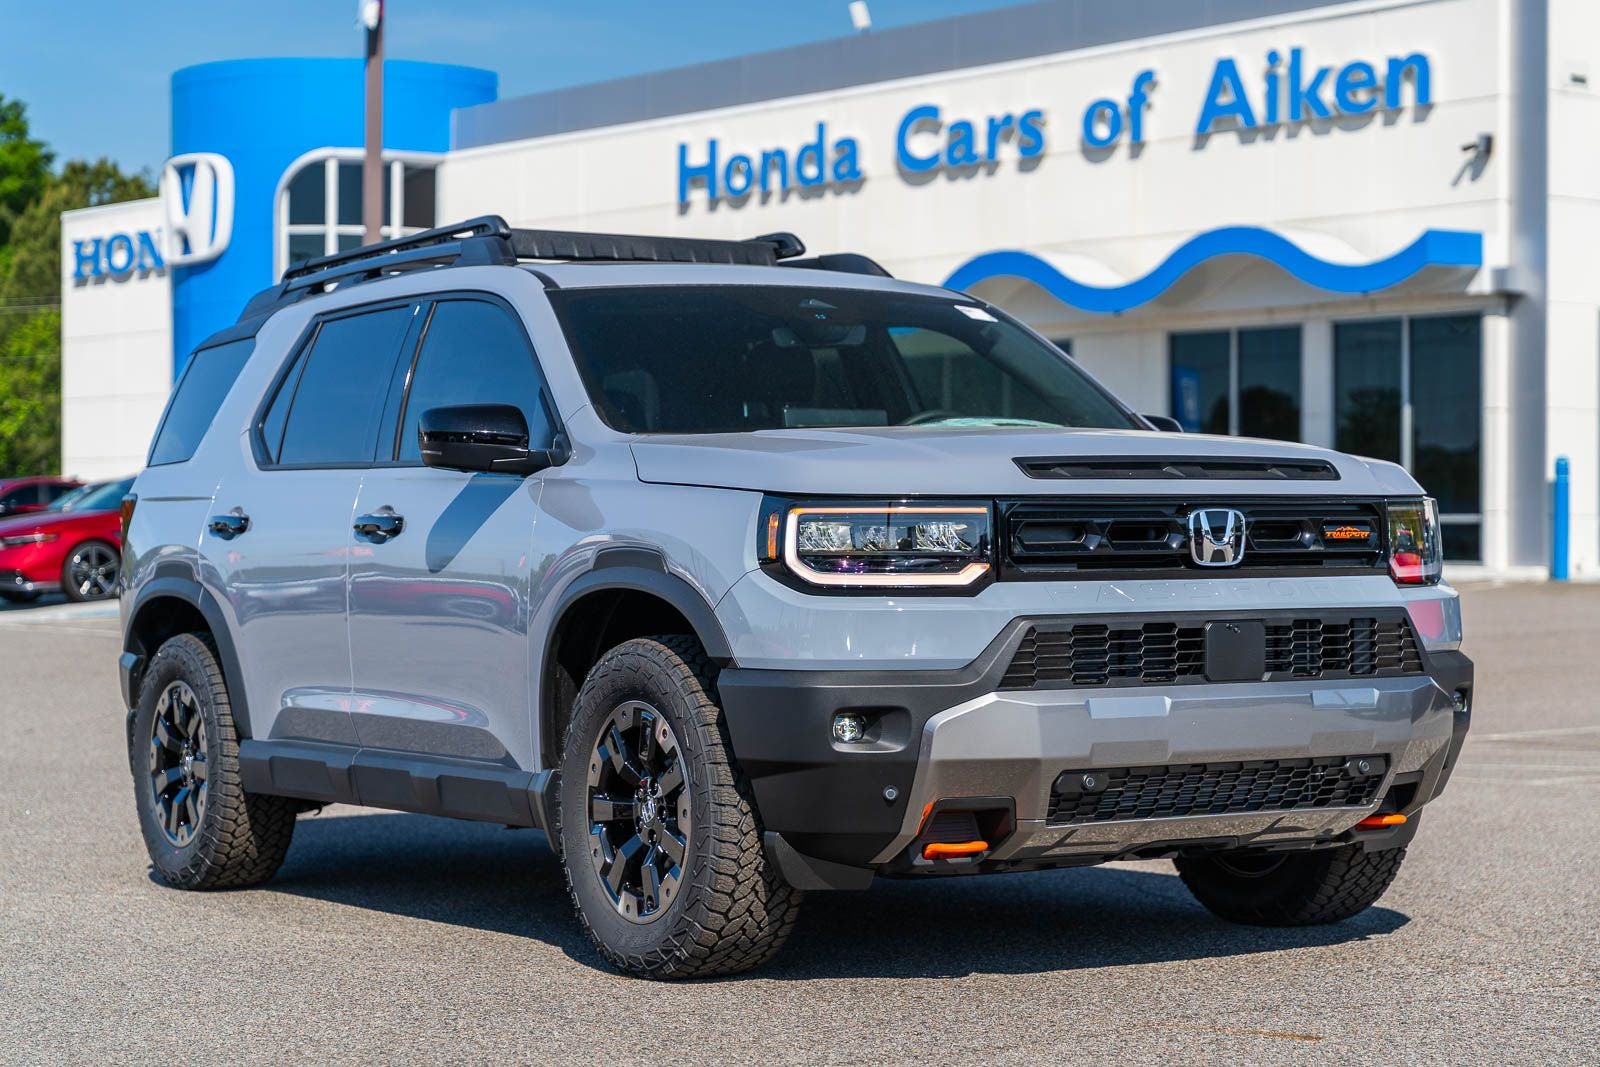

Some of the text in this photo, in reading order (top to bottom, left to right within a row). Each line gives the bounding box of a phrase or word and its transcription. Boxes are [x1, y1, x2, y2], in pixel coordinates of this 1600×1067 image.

[678, 46, 1431, 205] Honda Cars of Aiken
